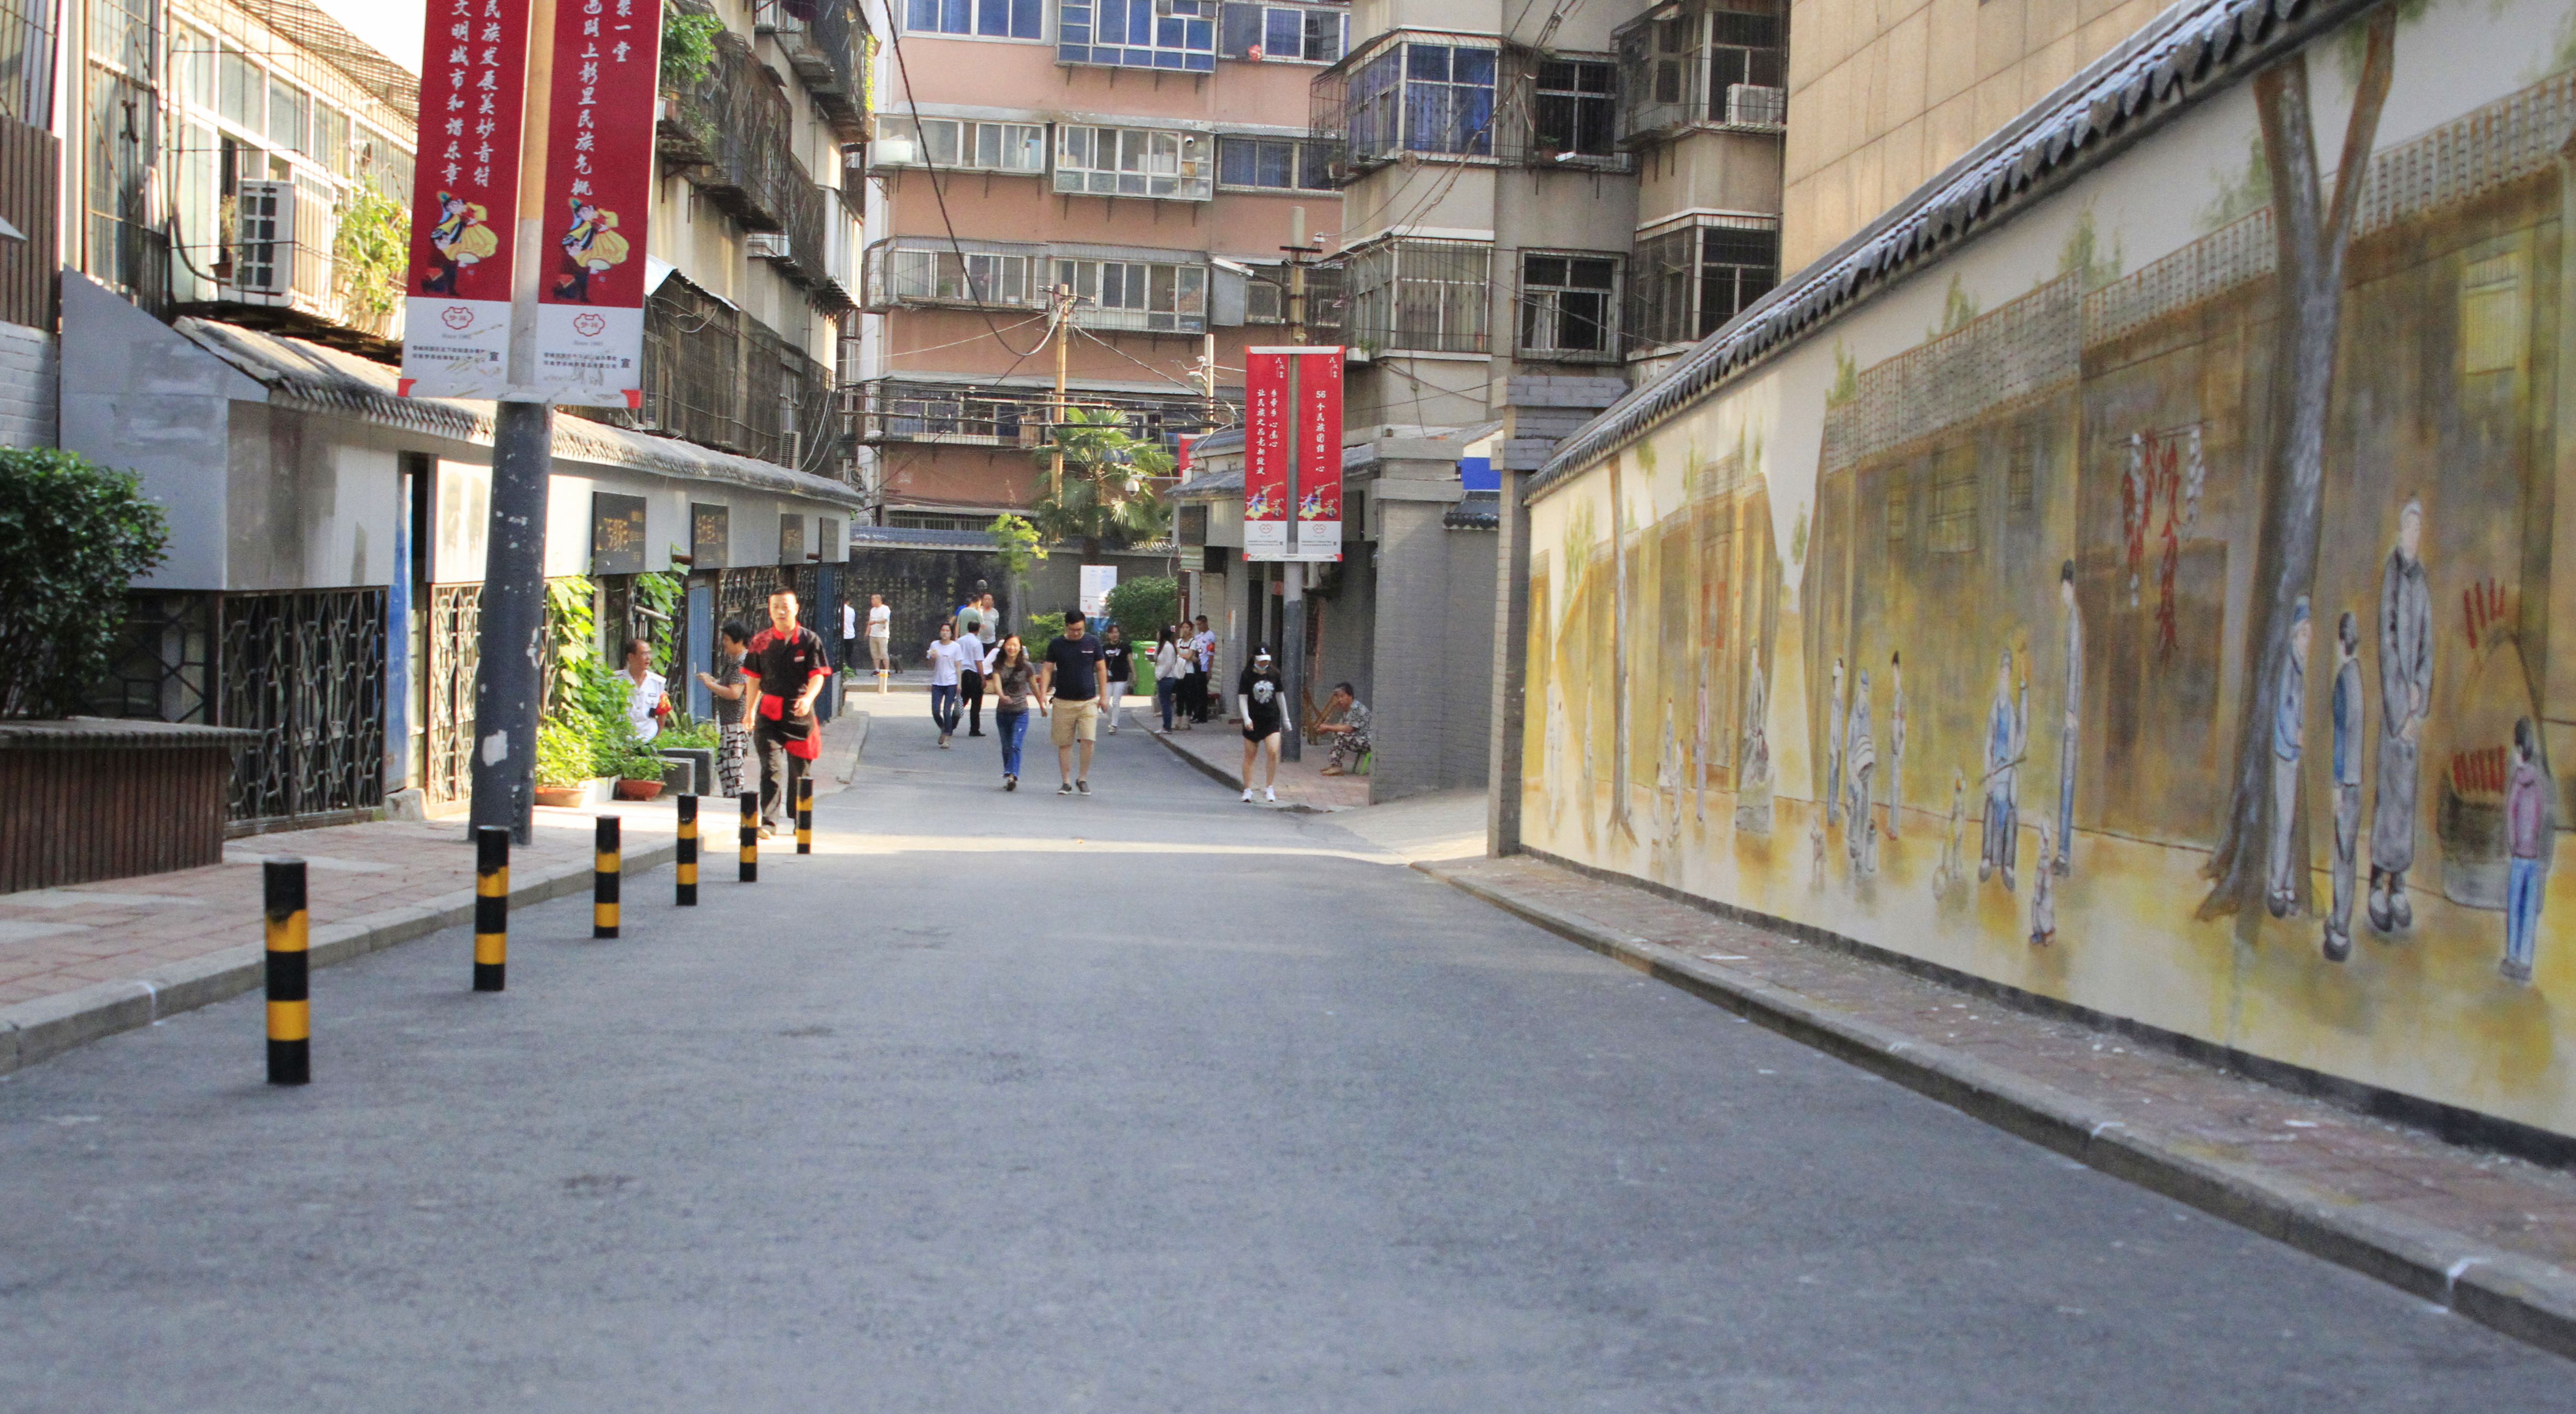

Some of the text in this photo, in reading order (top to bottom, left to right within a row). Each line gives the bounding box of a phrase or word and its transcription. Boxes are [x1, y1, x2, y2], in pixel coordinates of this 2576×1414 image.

[441, 0, 471, 185] 文明城市和谐乐章
[474, 0, 501, 187] 民族发展美妙音符
